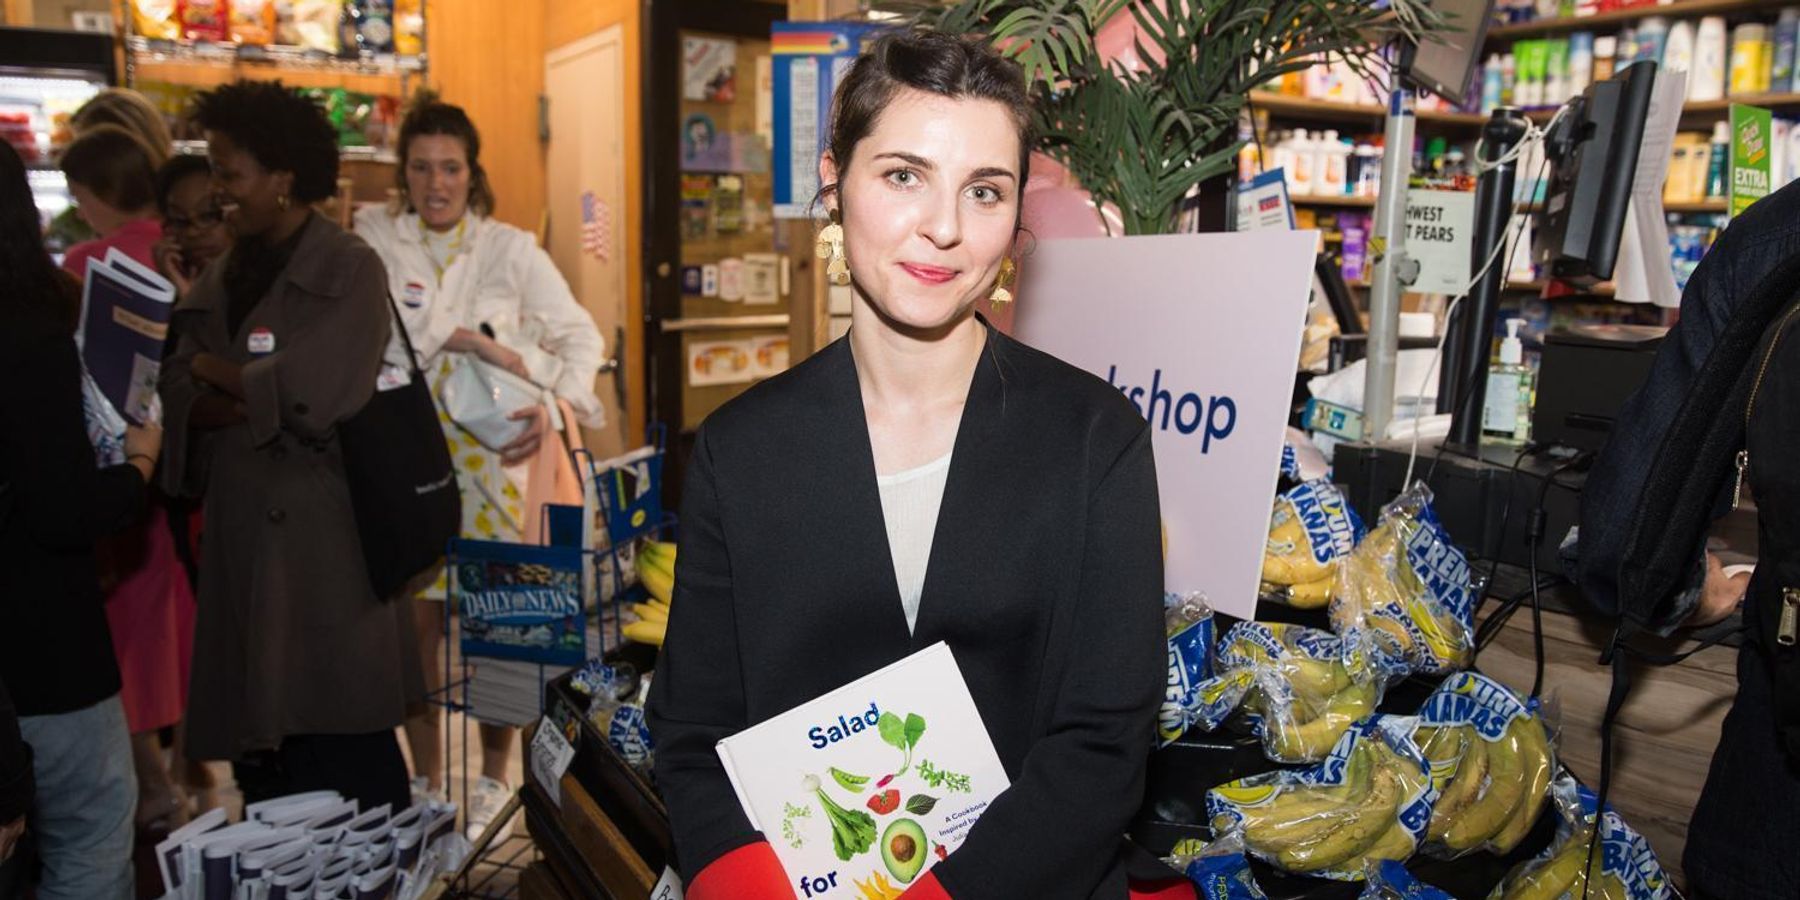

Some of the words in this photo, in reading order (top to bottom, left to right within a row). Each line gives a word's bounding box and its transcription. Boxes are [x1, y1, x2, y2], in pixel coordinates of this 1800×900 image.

[1735, 167, 1767, 188] EXTRA
[1415, 226, 1455, 243] PEARS
[464, 590, 512, 618] DAILY
[525, 588, 580, 616] NEWS
[808, 702, 880, 750] Salad
[951, 801, 987, 820] Cookbook
[939, 820, 968, 836] Inspired
[800, 870, 838, 898] for
